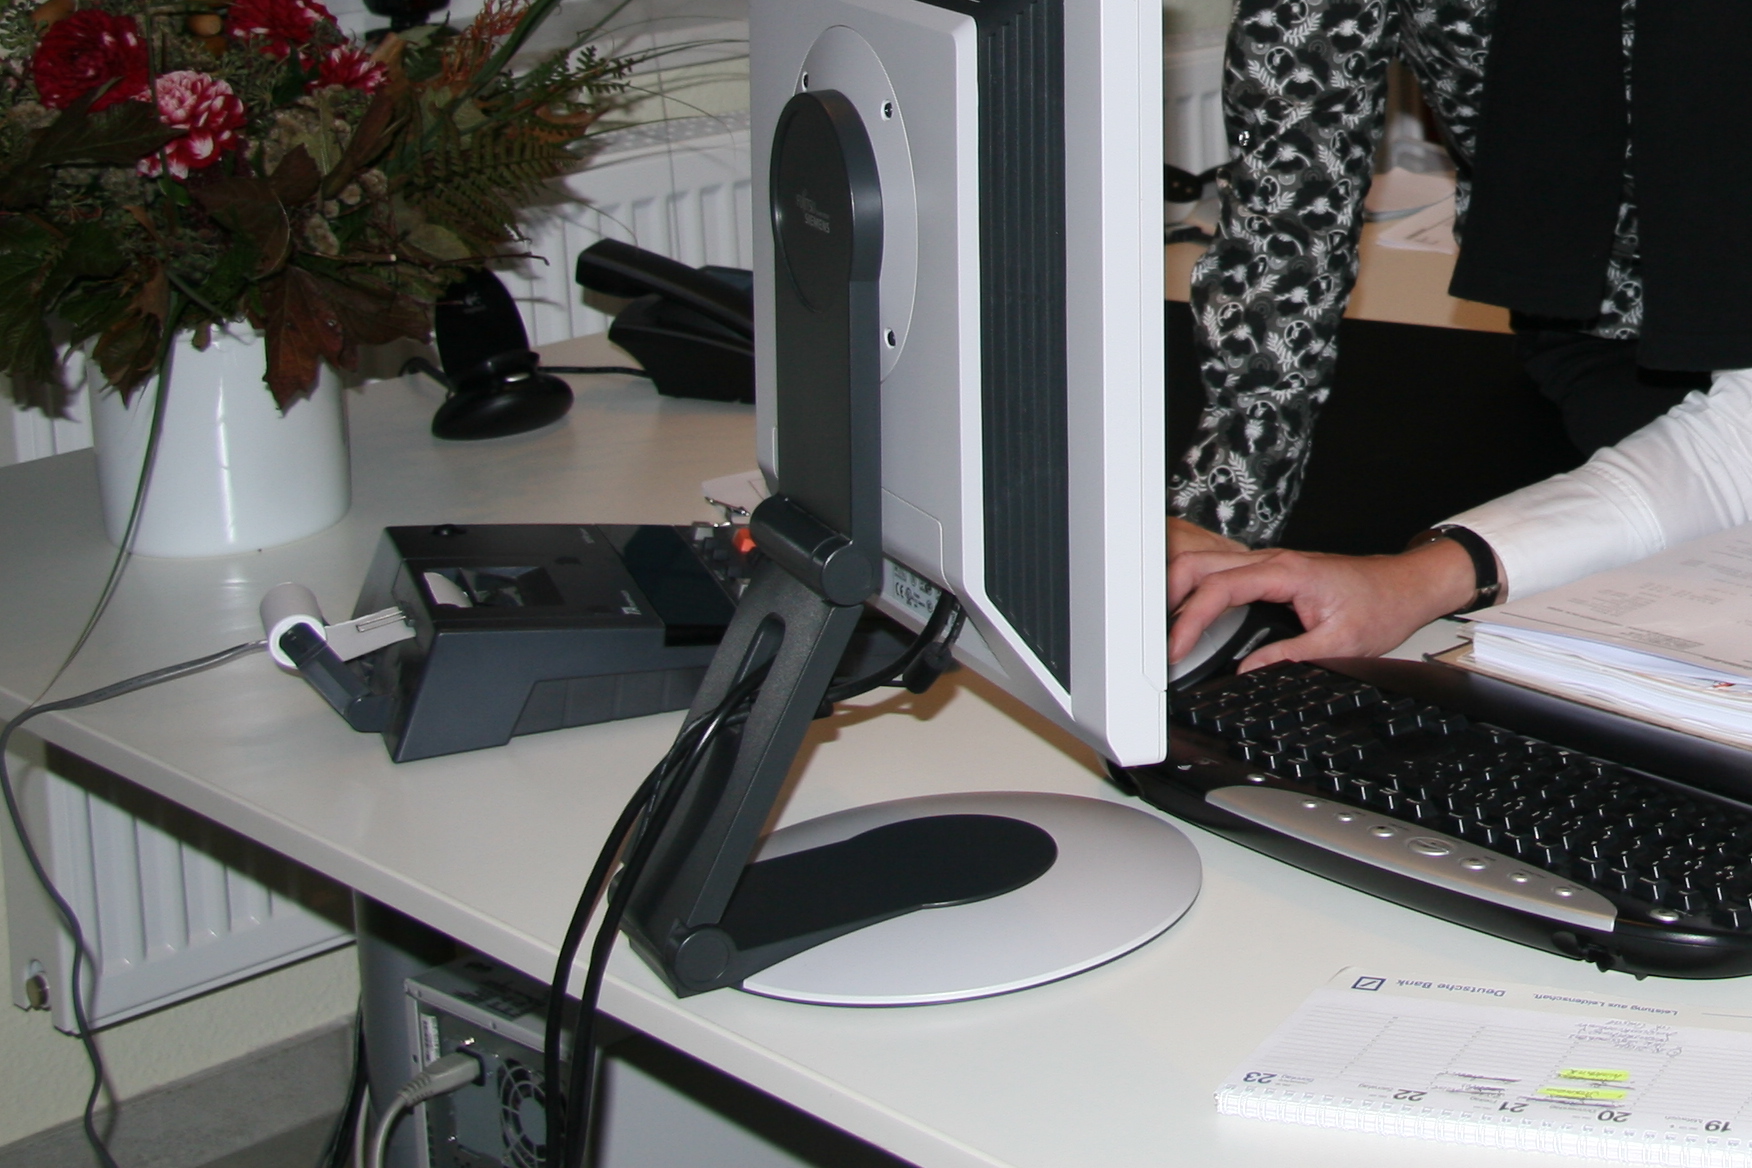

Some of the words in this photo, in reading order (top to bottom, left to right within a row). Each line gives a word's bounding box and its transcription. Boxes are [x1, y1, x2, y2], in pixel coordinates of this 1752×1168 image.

[1396, 979, 1433, 990] Bank
[1436, 982, 1506, 997] Deutsche
[1532, 993, 1606, 1008] Leidenschaft.
[1607, 1001, 1628, 1009] aus
[1630, 1004, 1678, 1016] Leistung
[1242, 1071, 1278, 1084] 23
[1392, 1089, 1428, 1102] 22
[1498, 1100, 1529, 1113] 21
[1597, 1110, 1632, 1123] 20
[1704, 1120, 1733, 1133] 19
